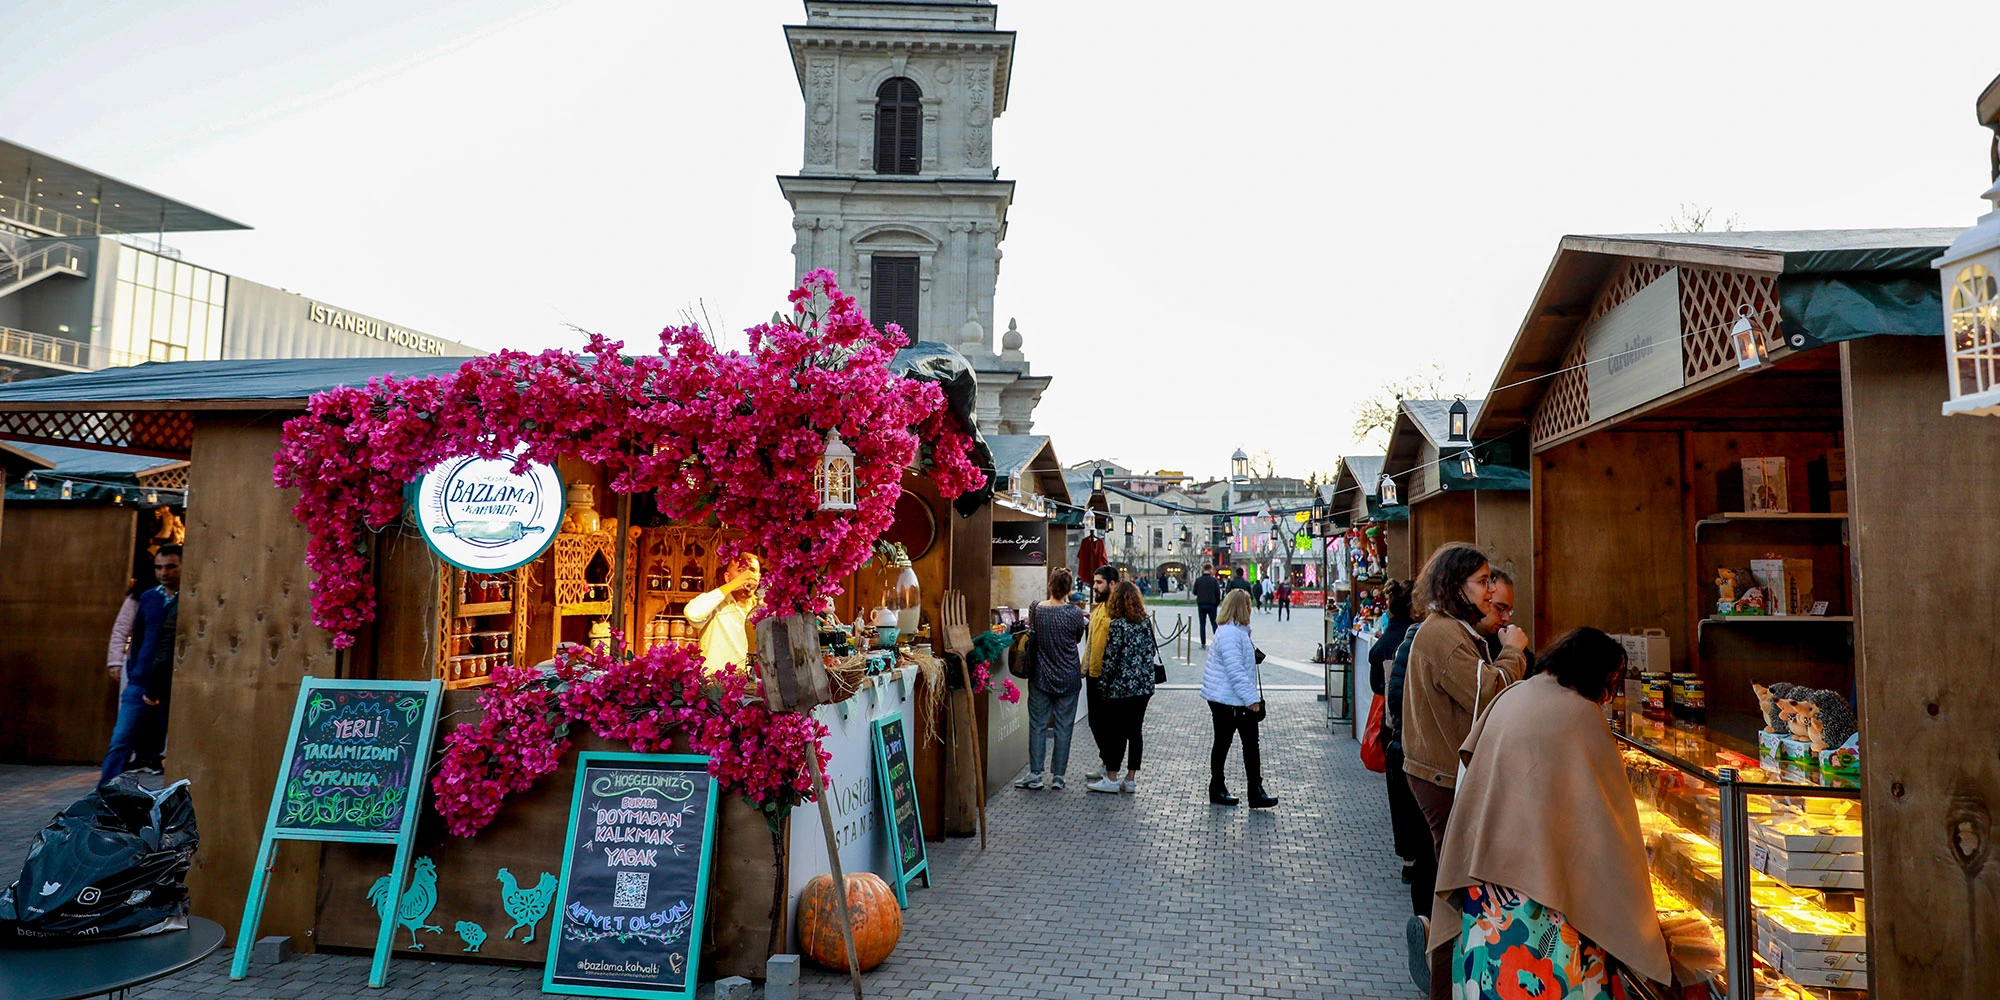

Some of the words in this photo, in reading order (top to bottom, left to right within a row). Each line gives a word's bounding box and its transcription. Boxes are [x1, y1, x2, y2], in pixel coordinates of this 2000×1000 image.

[309, 301, 385, 341] İSTANBUL
[386, 326, 446, 357] MODERN
[449, 479, 535, 505] BAZLAMA
[333, 715, 382, 739] YERLİ
[303, 742, 399, 762] TARLAMIZDAN
[614, 774, 680, 788] HOŞGELDİNİZ
[621, 796, 658, 809] BURADA
[596, 808, 682, 828] DOYMADAN
[594, 826, 674, 845] KALKMAK
[835, 811, 874, 851] STANB
[604, 847, 658, 868] YASAK
[568, 901, 626, 931] AFİYET
[629, 899, 688, 931] OLSUN
